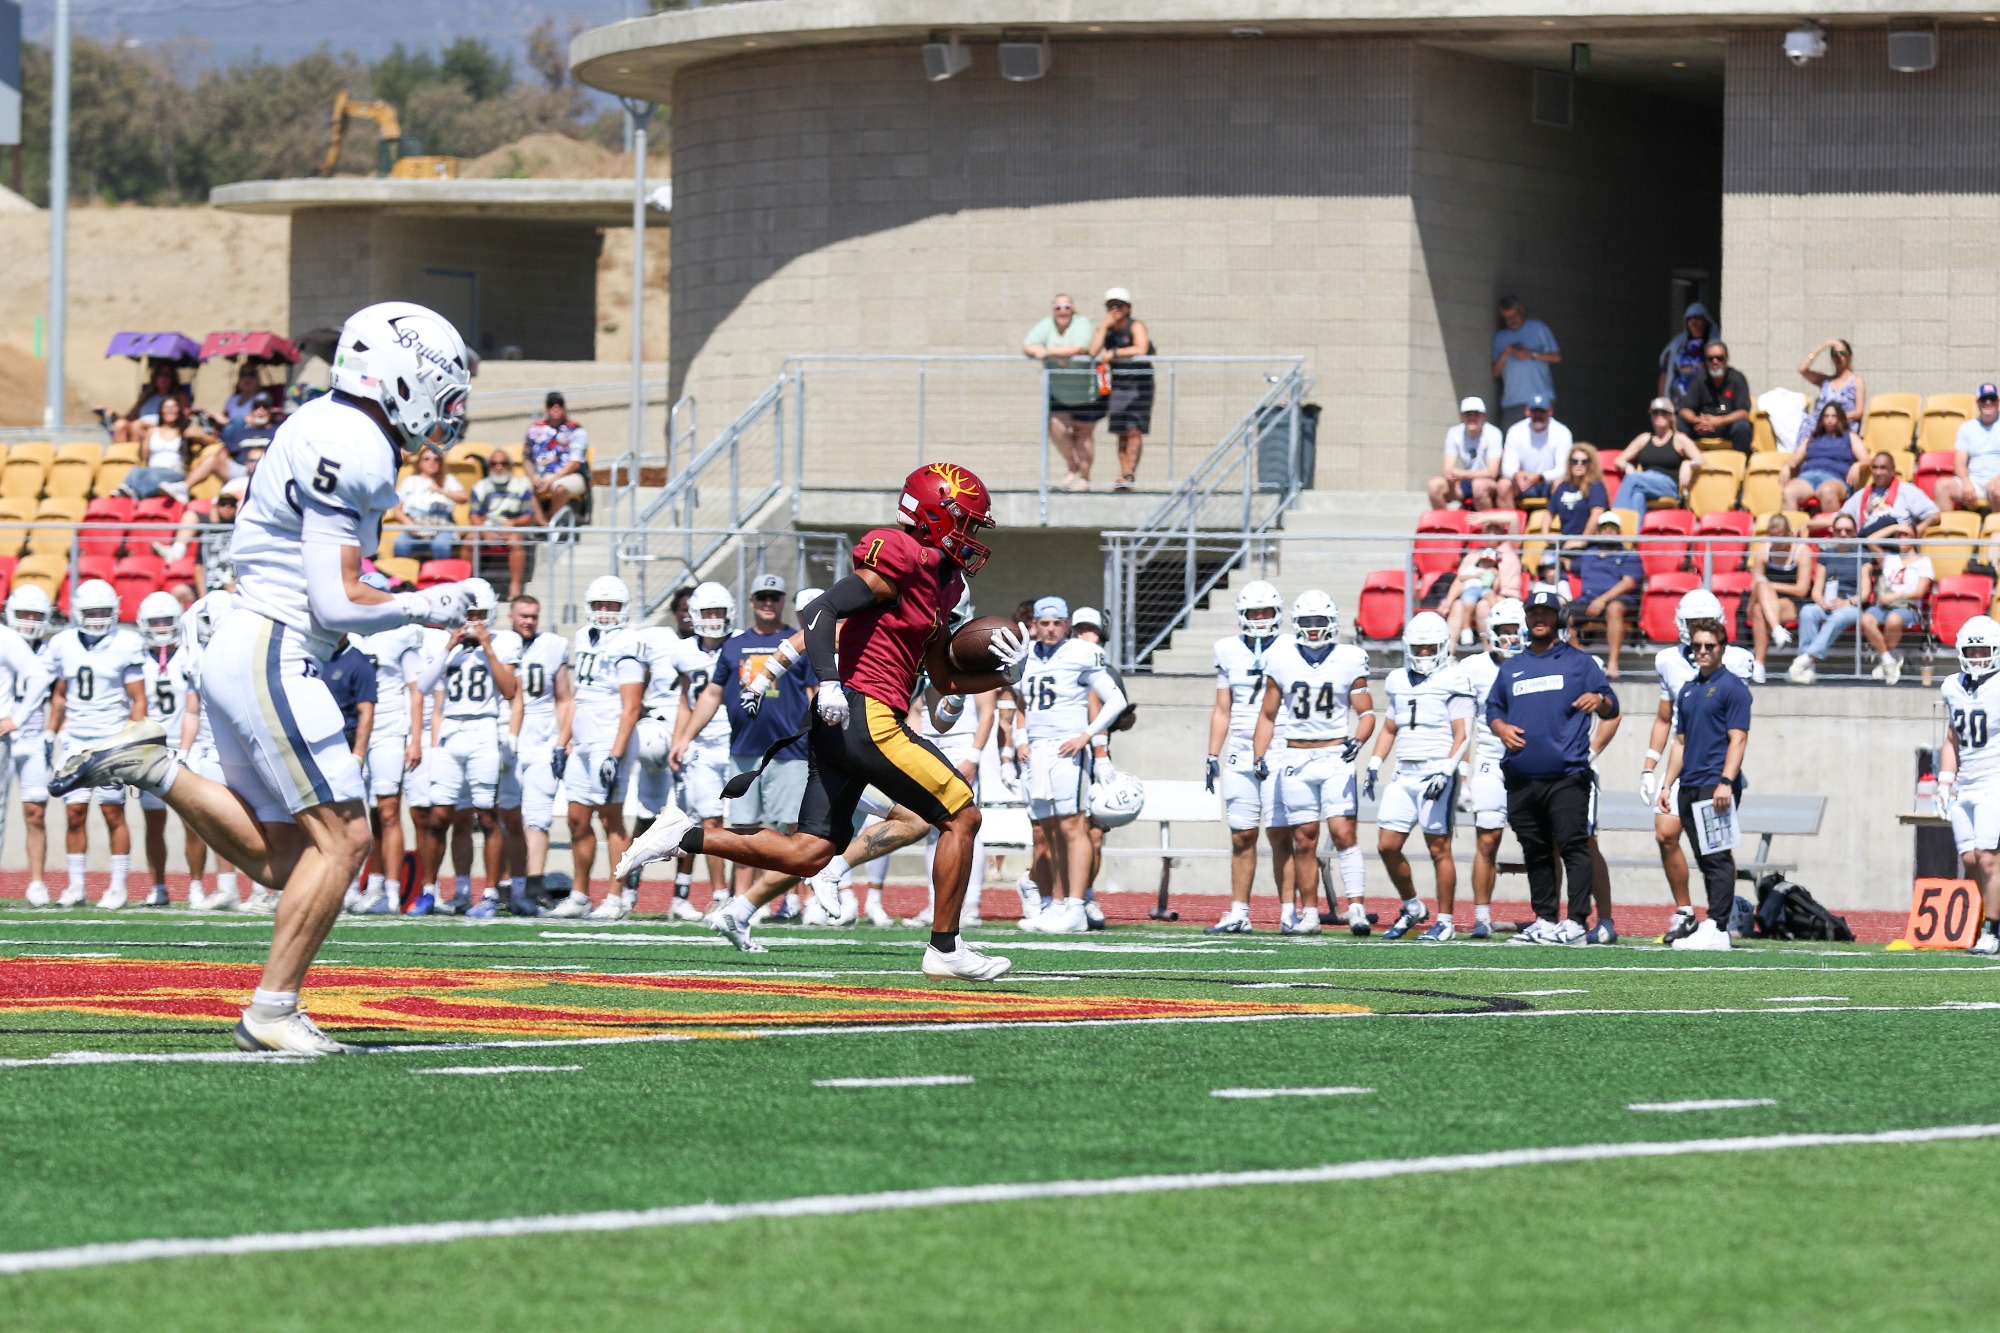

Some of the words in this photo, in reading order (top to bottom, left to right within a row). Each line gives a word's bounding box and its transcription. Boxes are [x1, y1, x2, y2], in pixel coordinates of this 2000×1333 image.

[392, 328, 456, 374] Bruins
[312, 456, 341, 494] 5
[864, 538, 884, 567] 1
[77, 666, 94, 701] 0
[446, 664, 489, 702] 38
[1027, 676, 1057, 712] 16
[1247, 669, 1264, 704] 7
[1291, 681, 1334, 720] 34
[1407, 699, 1418, 731] 1
[1953, 709, 1988, 748] 20
[1914, 887, 1970, 942] 50
